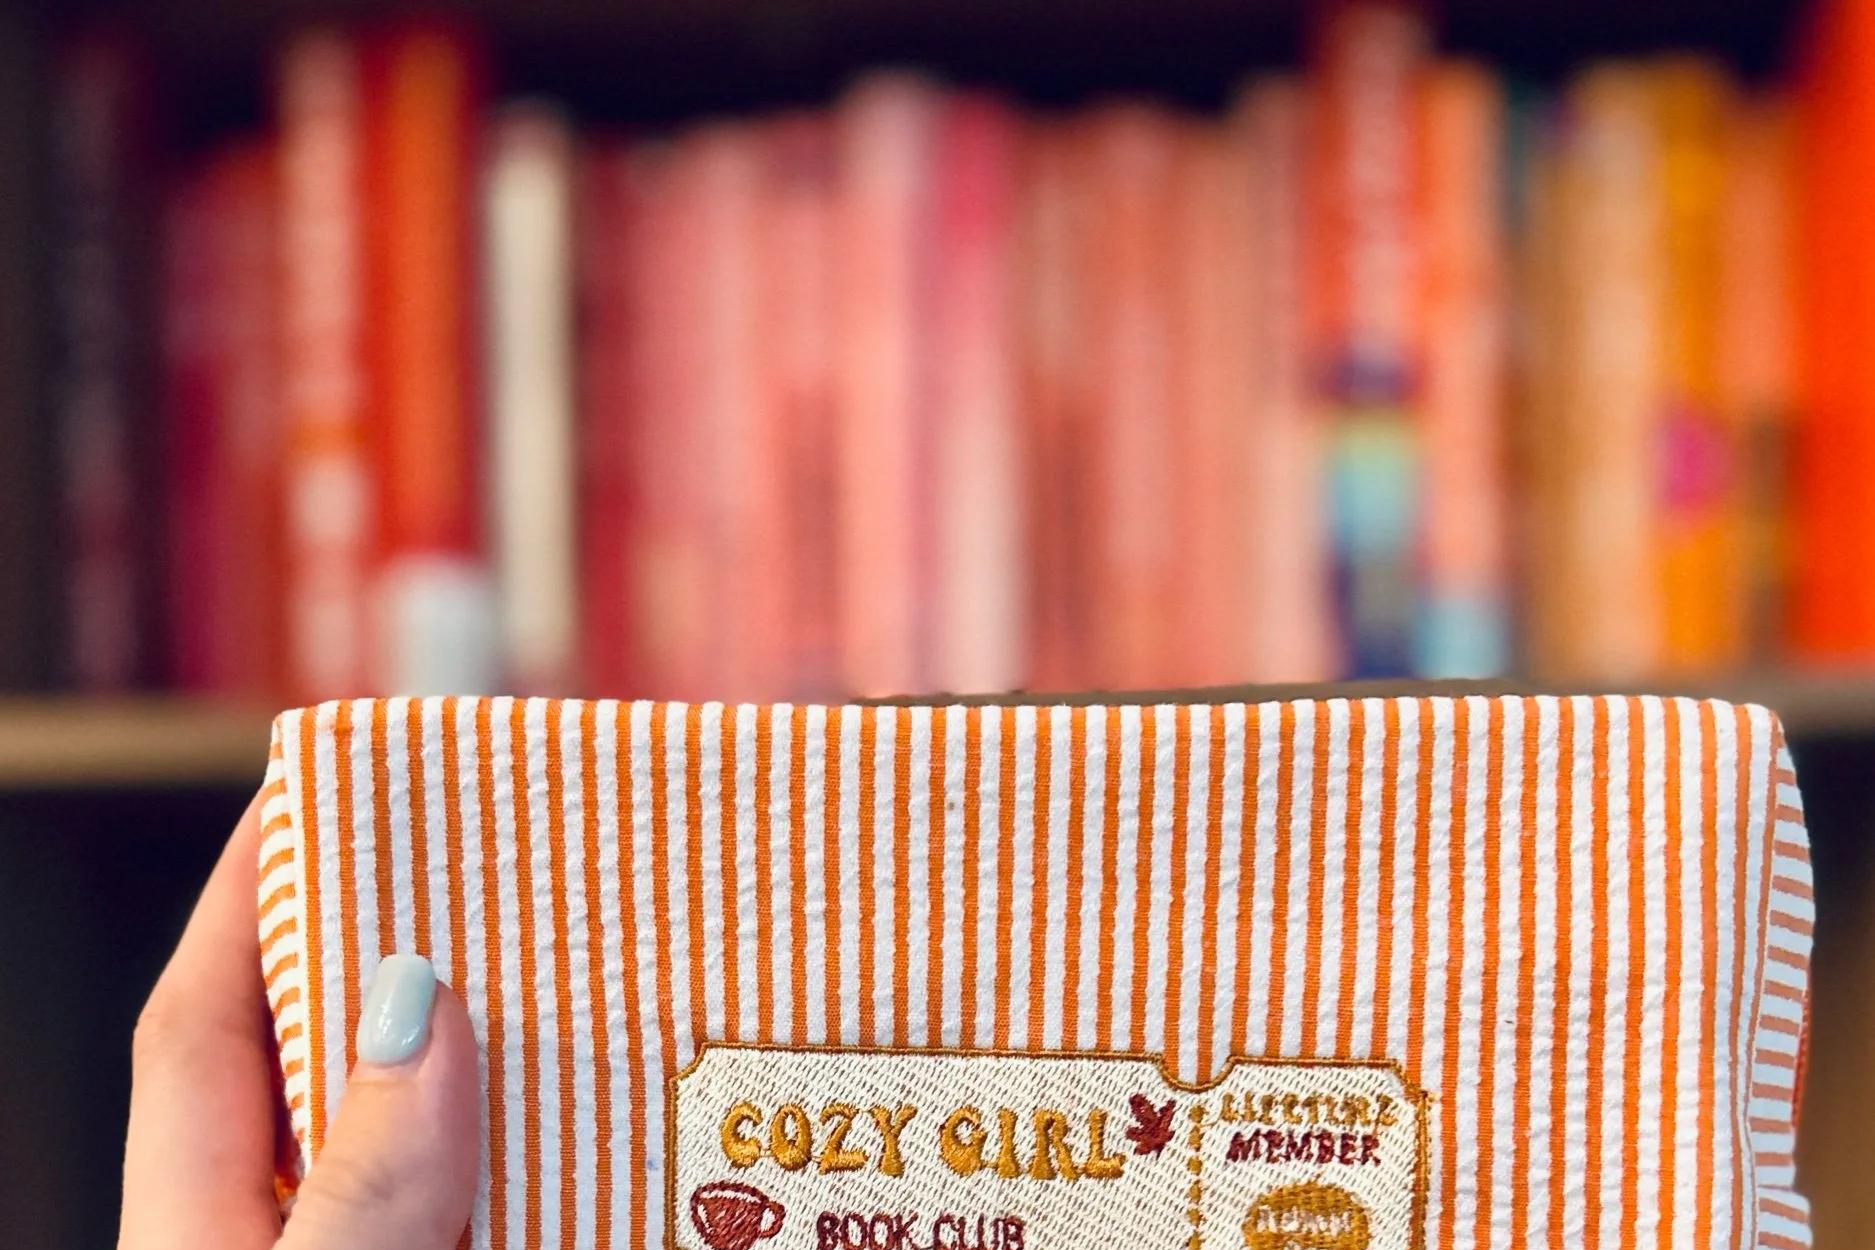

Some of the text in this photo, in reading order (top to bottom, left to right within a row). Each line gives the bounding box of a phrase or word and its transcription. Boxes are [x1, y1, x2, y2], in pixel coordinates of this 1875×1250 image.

[720, 1101, 1126, 1181] COZY GIRL
[1226, 1129, 1381, 1167] MEMBER
